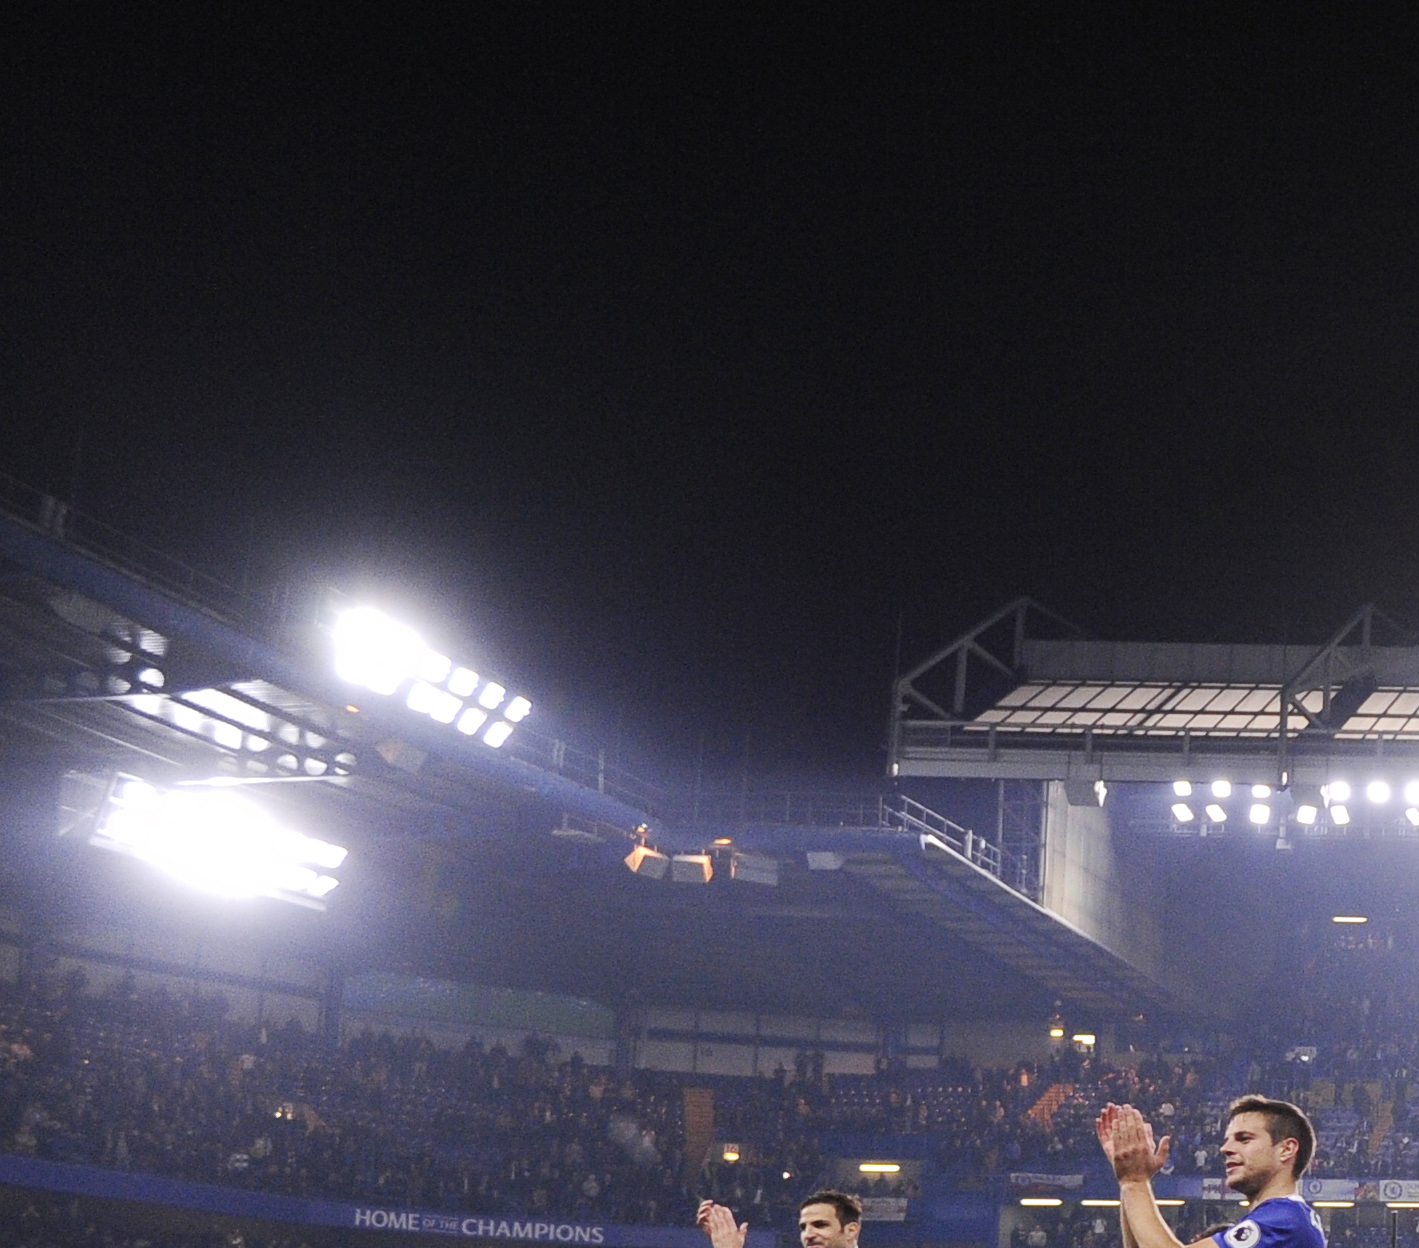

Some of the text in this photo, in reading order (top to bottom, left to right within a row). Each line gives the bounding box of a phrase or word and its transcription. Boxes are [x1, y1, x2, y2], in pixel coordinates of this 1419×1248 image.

[354, 1208, 604, 1244] HOME OF THE CHAMPIONS
